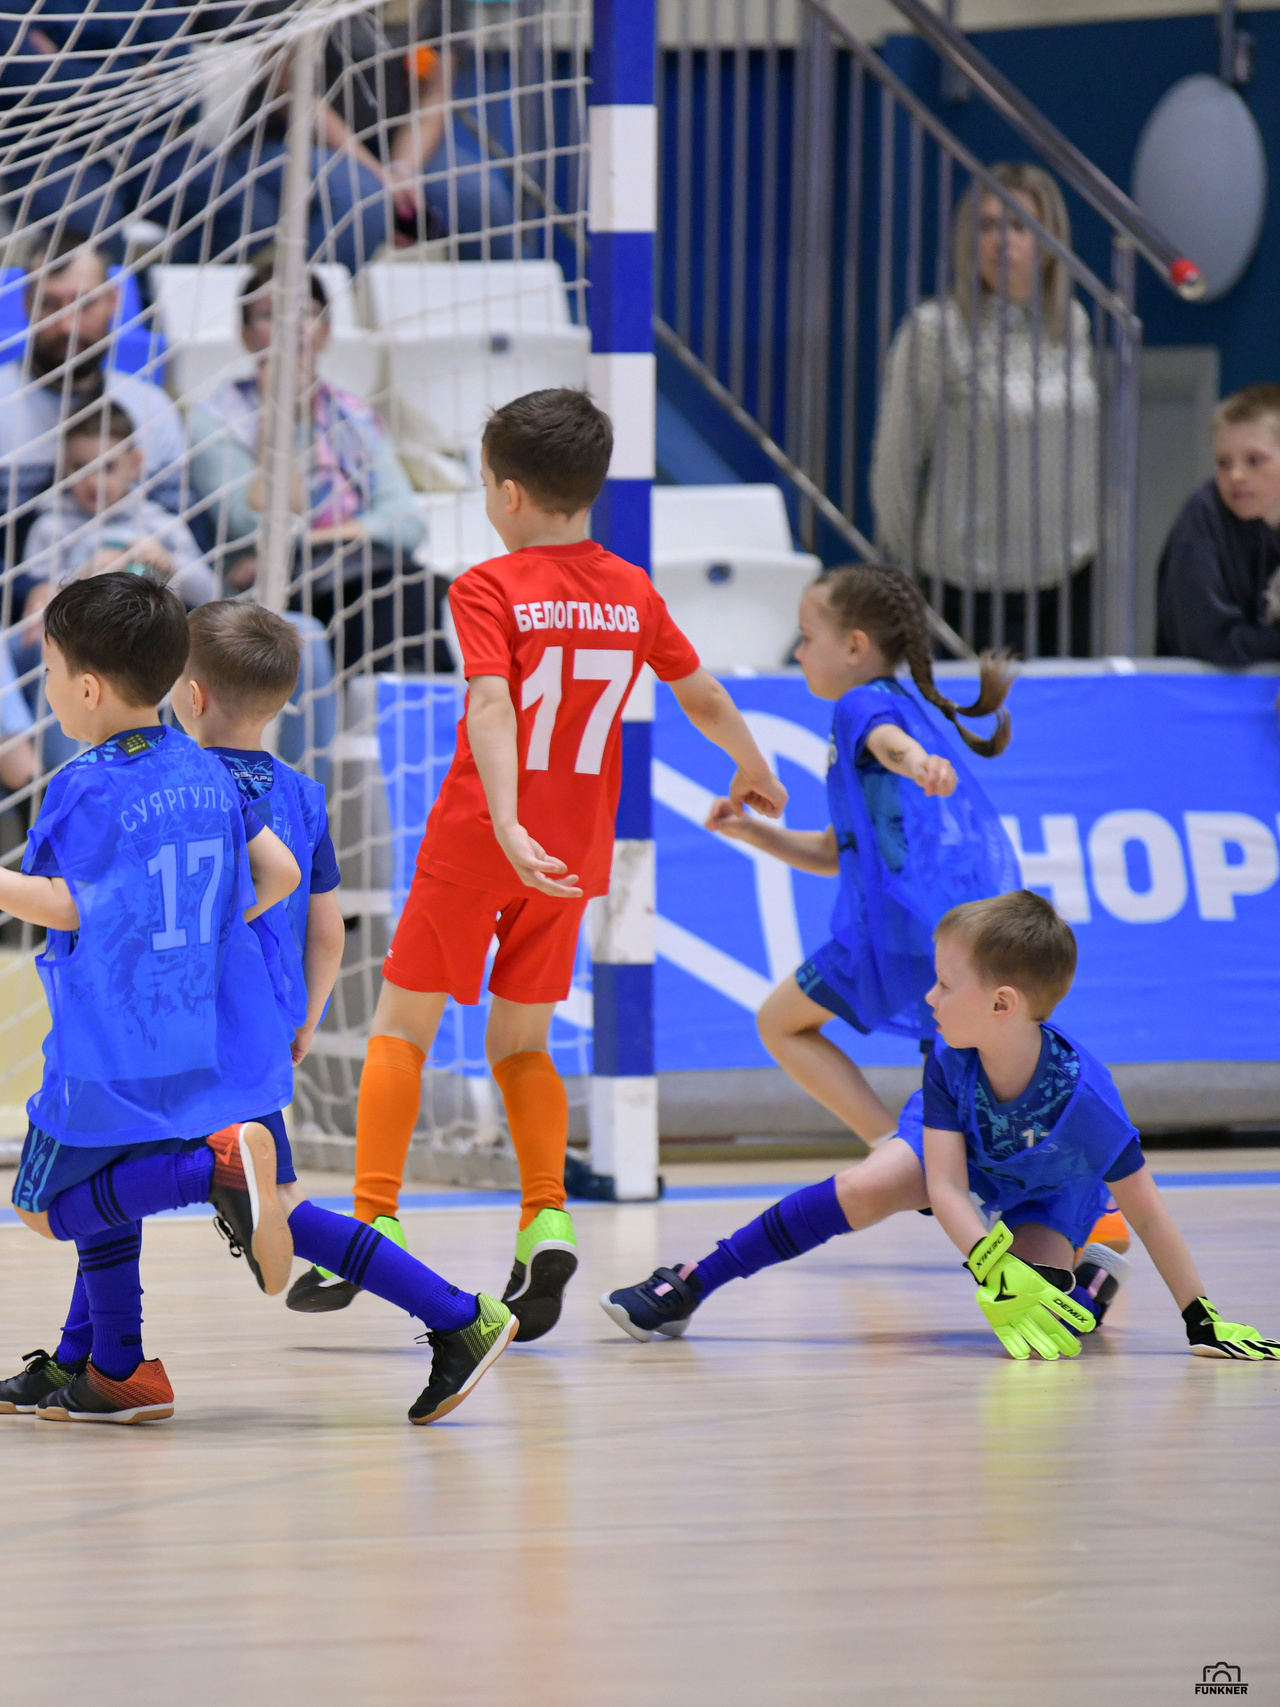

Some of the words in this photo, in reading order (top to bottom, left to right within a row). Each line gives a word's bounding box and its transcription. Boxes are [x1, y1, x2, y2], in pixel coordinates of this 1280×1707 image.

[512, 600, 640, 634] БЕЛОГЛАЗОВ
[521, 645, 635, 775] 17
[147, 836, 225, 951] 17
[975, 1232, 1006, 1270] DEMIX
[1053, 1298, 1089, 1324] DEMIX
